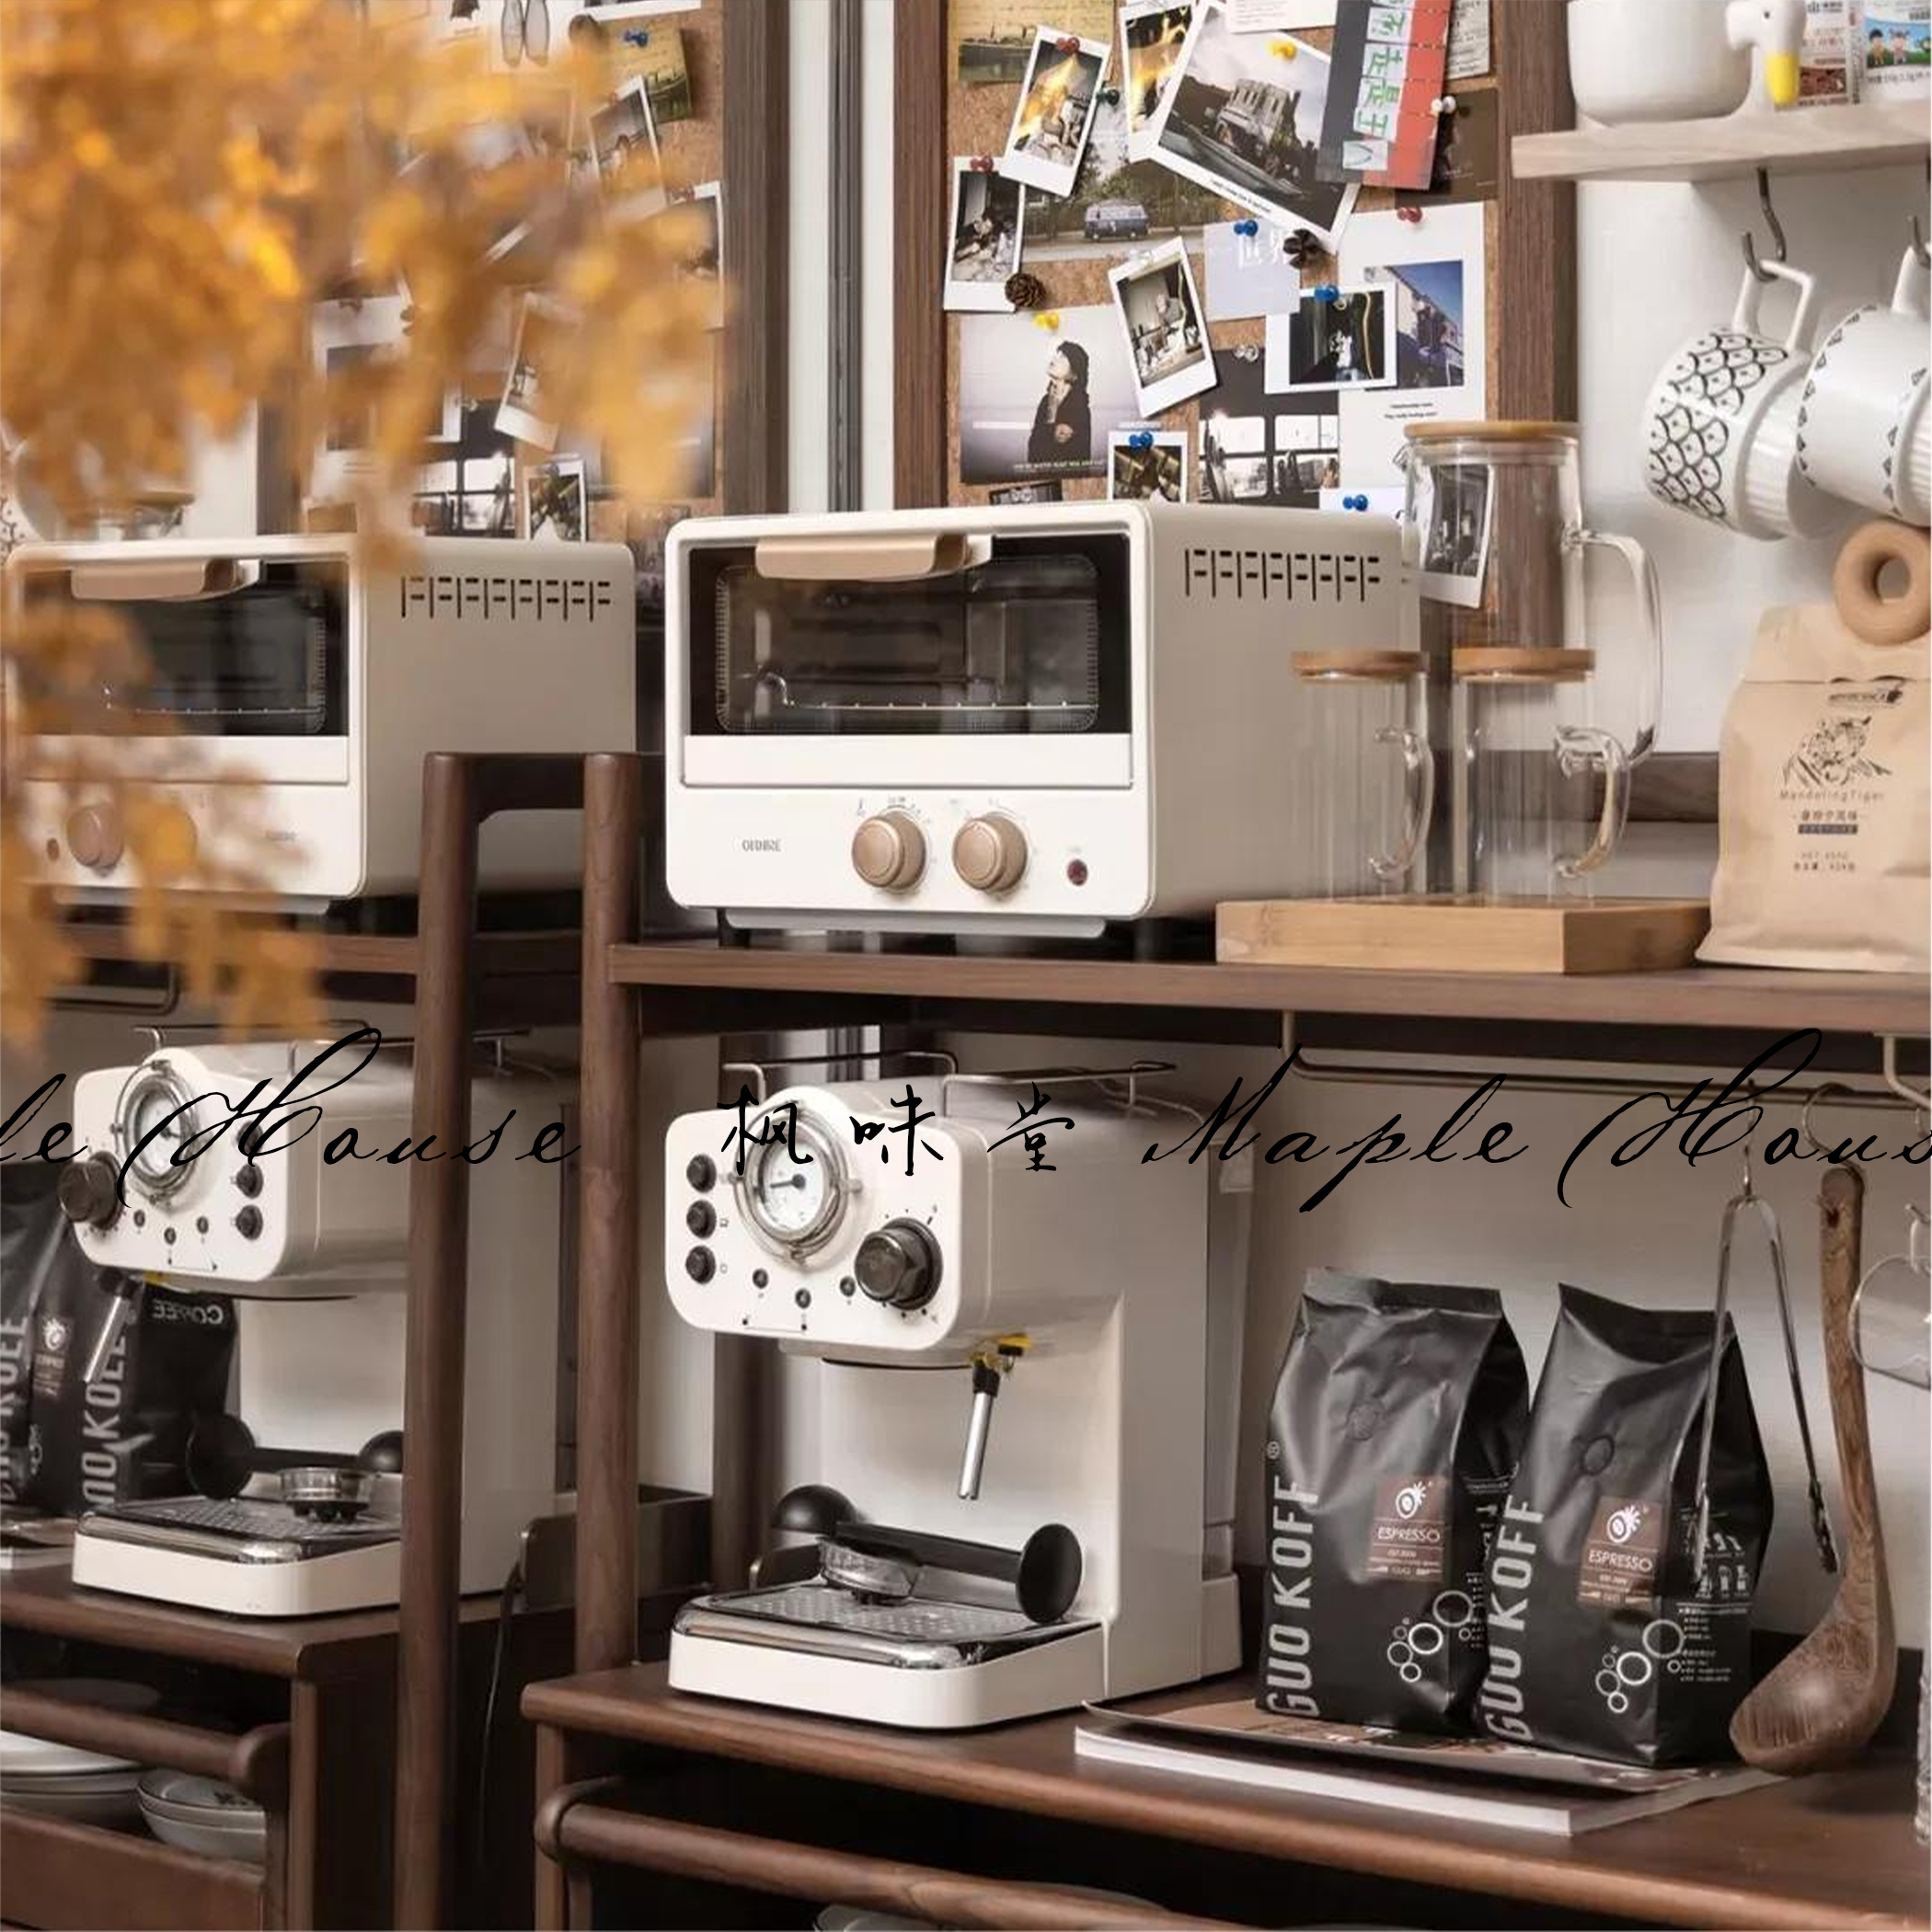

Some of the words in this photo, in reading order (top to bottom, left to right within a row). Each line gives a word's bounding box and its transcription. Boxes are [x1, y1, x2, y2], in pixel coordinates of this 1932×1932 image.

[1271, 1474, 1319, 1609] KOFF
[1377, 1525, 1441, 1543] ESPRESSO
[1487, 1493, 1545, 1632] KOFF
[1588, 1549, 1653, 1572] ESPRESSO
[1265, 1623, 1320, 1717] GUO
